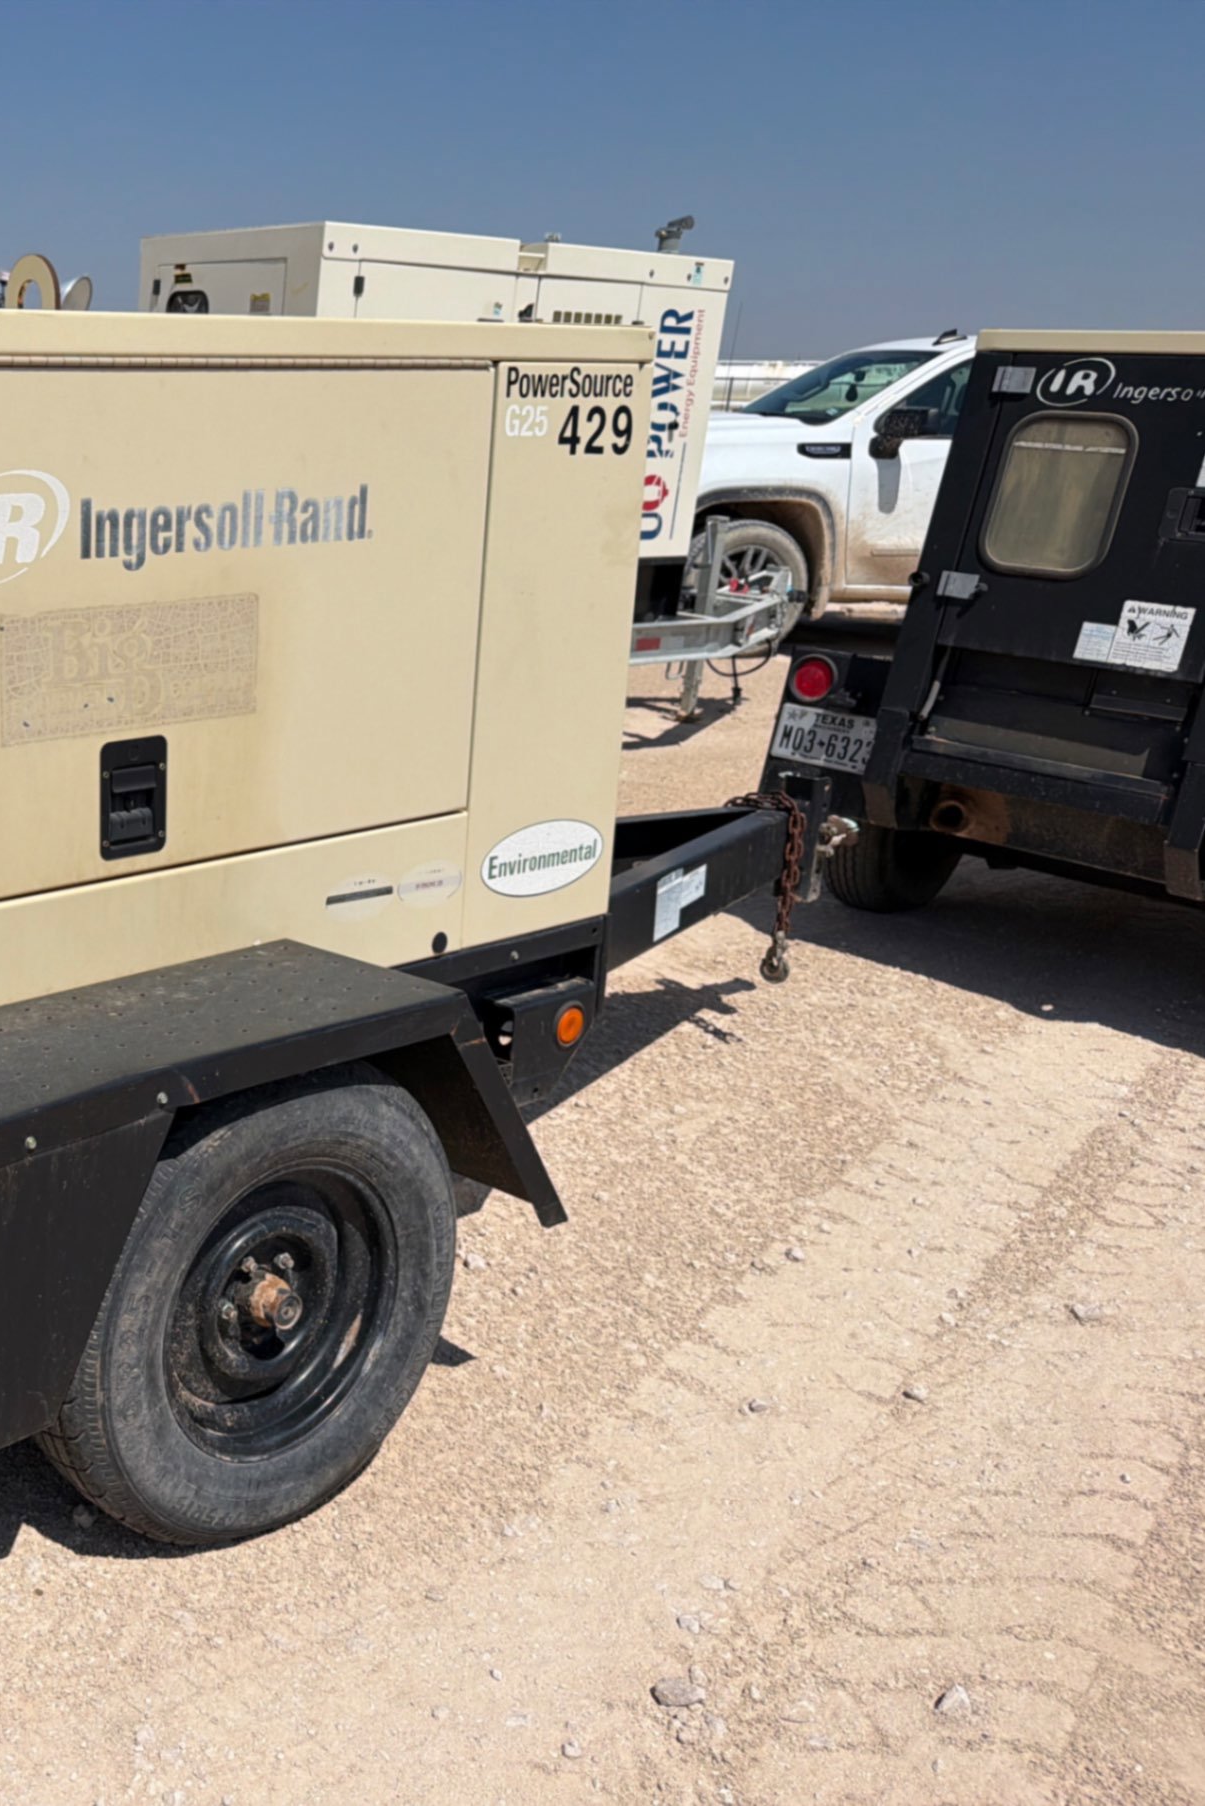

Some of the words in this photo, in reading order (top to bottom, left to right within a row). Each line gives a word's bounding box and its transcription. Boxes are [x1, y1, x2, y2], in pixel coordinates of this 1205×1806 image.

[685, 309, 705, 386] Equipment
[506, 366, 634, 398] PowerSource
[1112, 382, 1205, 404] Ingerso
[505, 404, 548, 437] G25
[557, 404, 633, 456] 429
[679, 390, 695, 438] Energy
[1137, 606, 1189, 620] WARNING
[814, 712, 855, 730] TEXAS
[488, 838, 598, 880] Environmental
